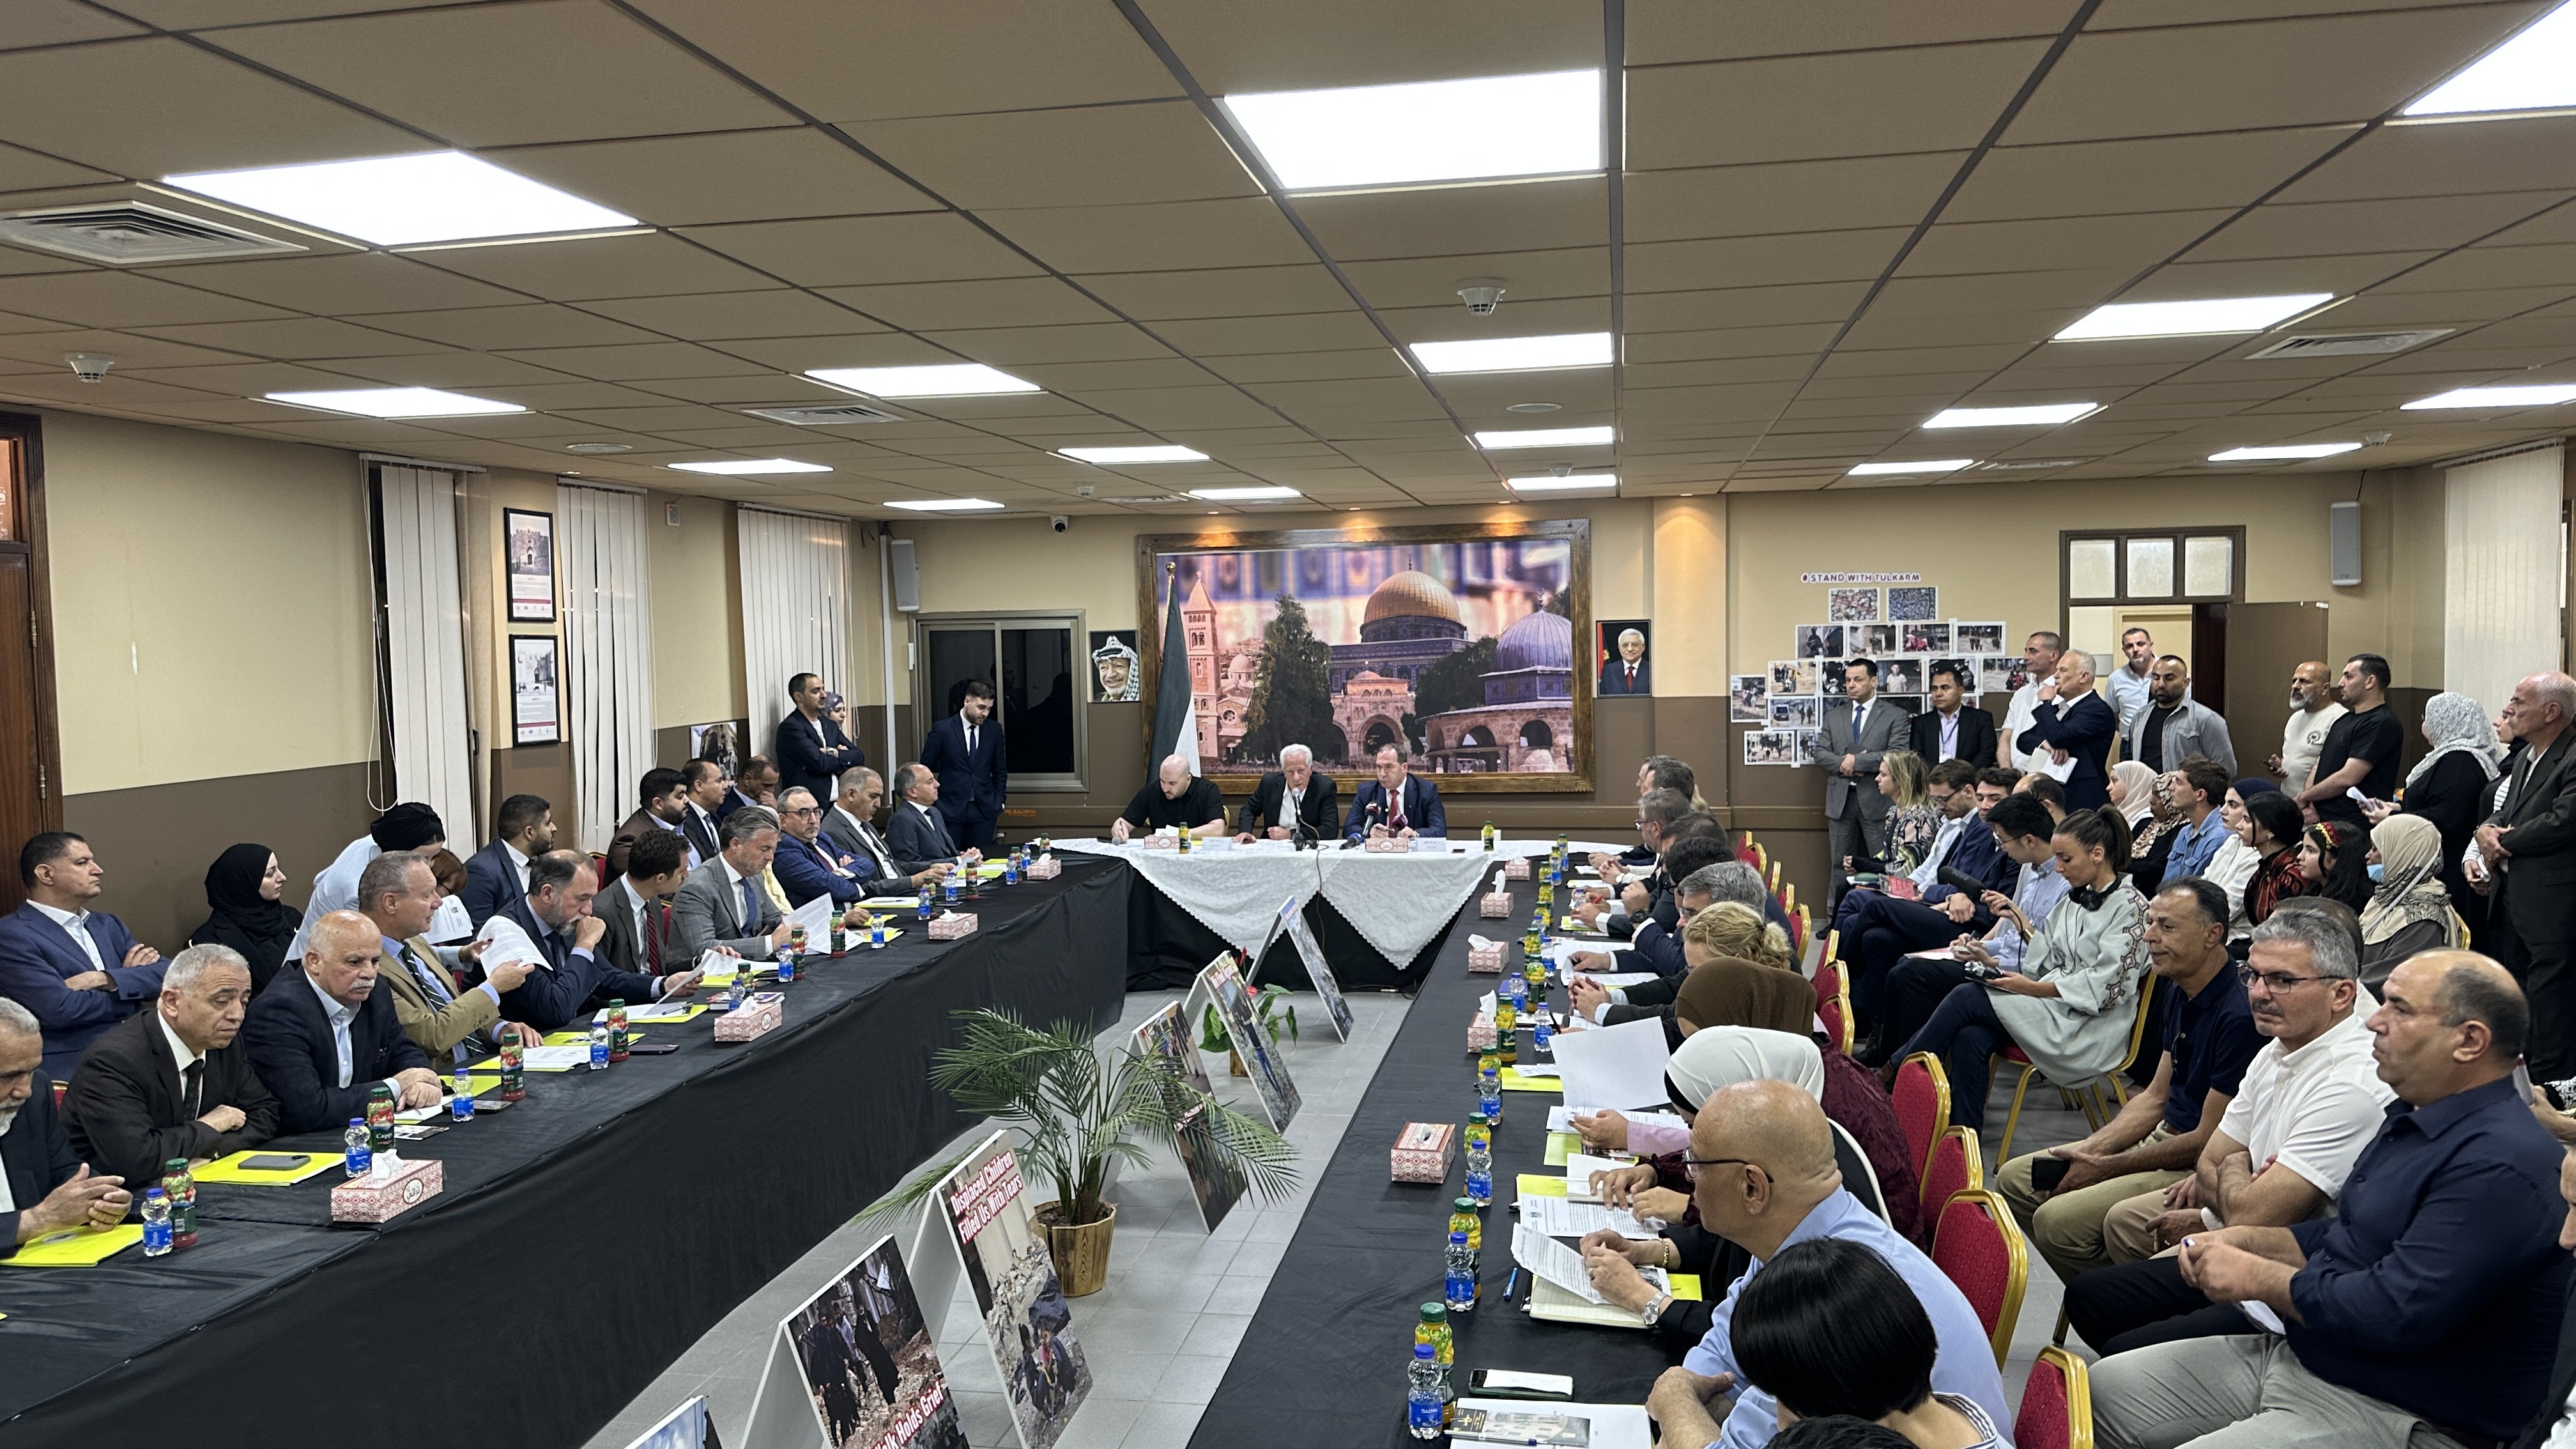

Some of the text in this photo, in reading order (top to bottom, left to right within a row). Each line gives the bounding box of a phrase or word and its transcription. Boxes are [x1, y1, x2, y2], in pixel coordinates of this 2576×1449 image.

[1847, 574, 1872, 582] WITH
[950, 1151, 1014, 1216] Displaced Children
[957, 1174, 1023, 1245] Filled Us With Tears
[894, 1406, 923, 1445] Holds
[919, 1380, 944, 1418] Grief
